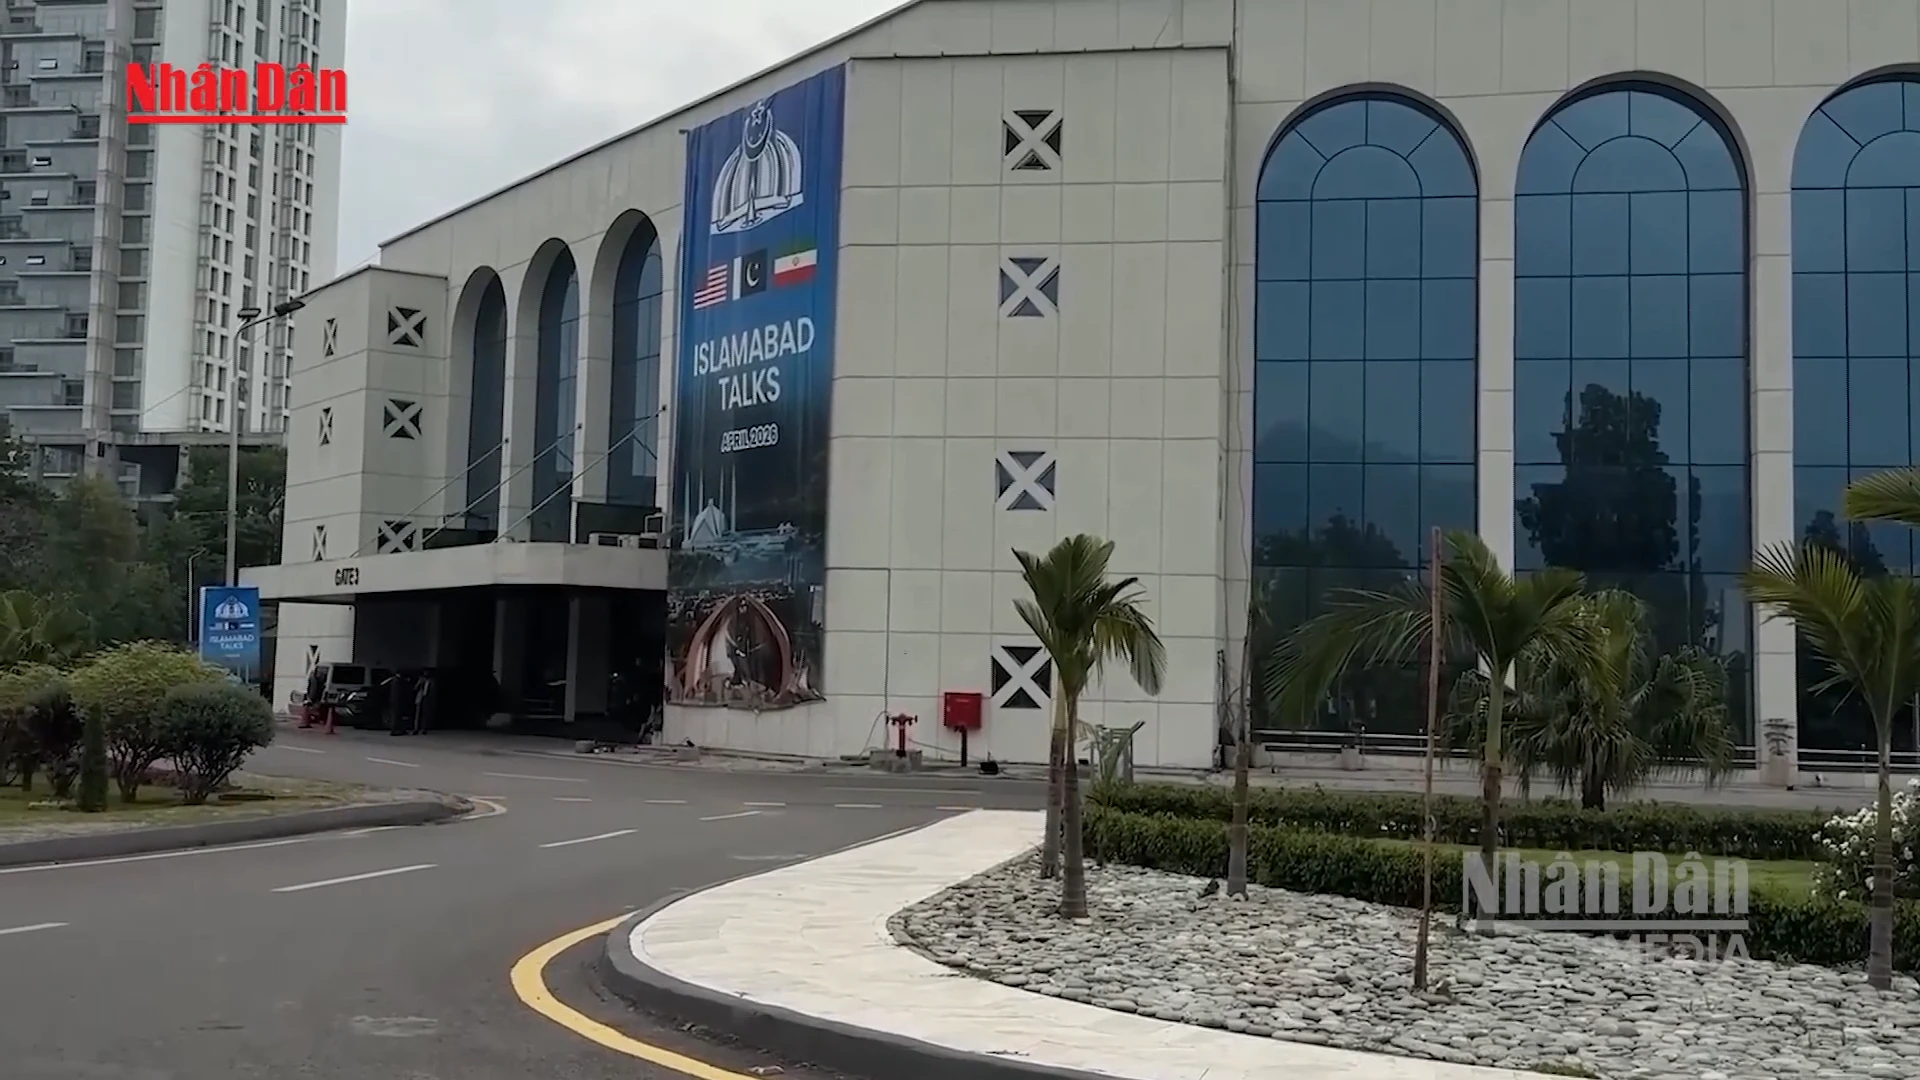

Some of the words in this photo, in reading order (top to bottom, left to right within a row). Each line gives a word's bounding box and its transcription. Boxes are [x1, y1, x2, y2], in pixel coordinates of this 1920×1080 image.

[693, 316, 815, 377] ISLAMABAD
[718, 366, 780, 411] TALKS
[721, 429, 749, 453] APRIL
